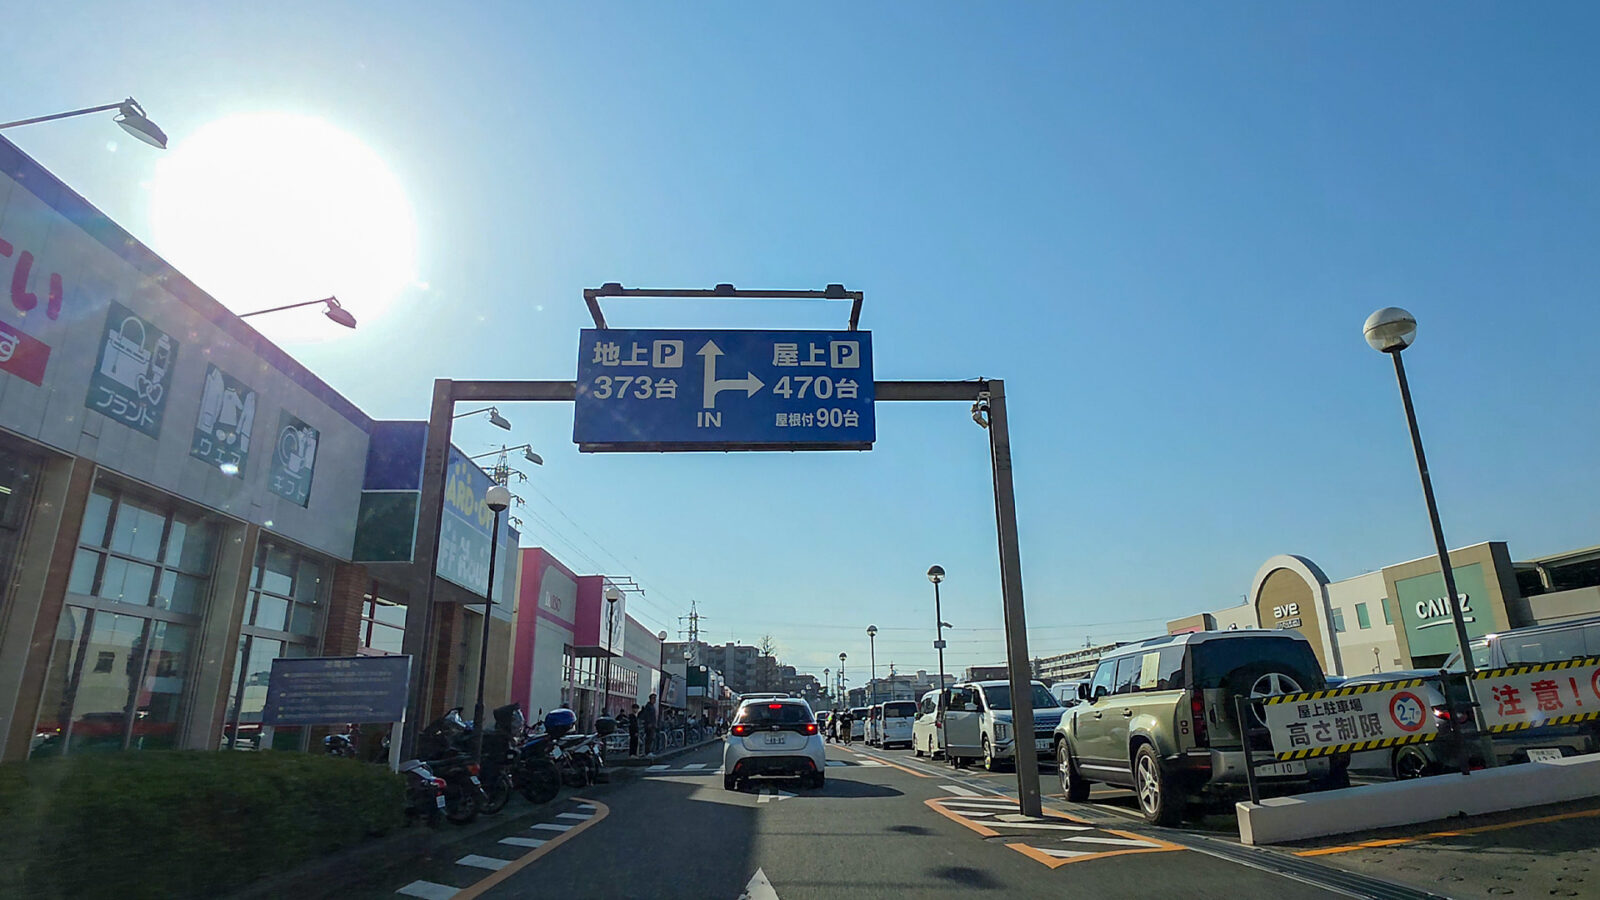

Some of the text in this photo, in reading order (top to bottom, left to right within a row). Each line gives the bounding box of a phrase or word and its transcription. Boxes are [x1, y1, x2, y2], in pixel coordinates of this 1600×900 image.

[0, 238, 62, 320] い
[593, 375, 678, 400] 373台
[773, 375, 860, 399] 470台
[696, 411, 722, 427] IN
[1273, 602, 1299, 618] ave
[1297, 698, 1363, 719] 屋上駐車場
[1286, 712, 1383, 748] 高さ制限
